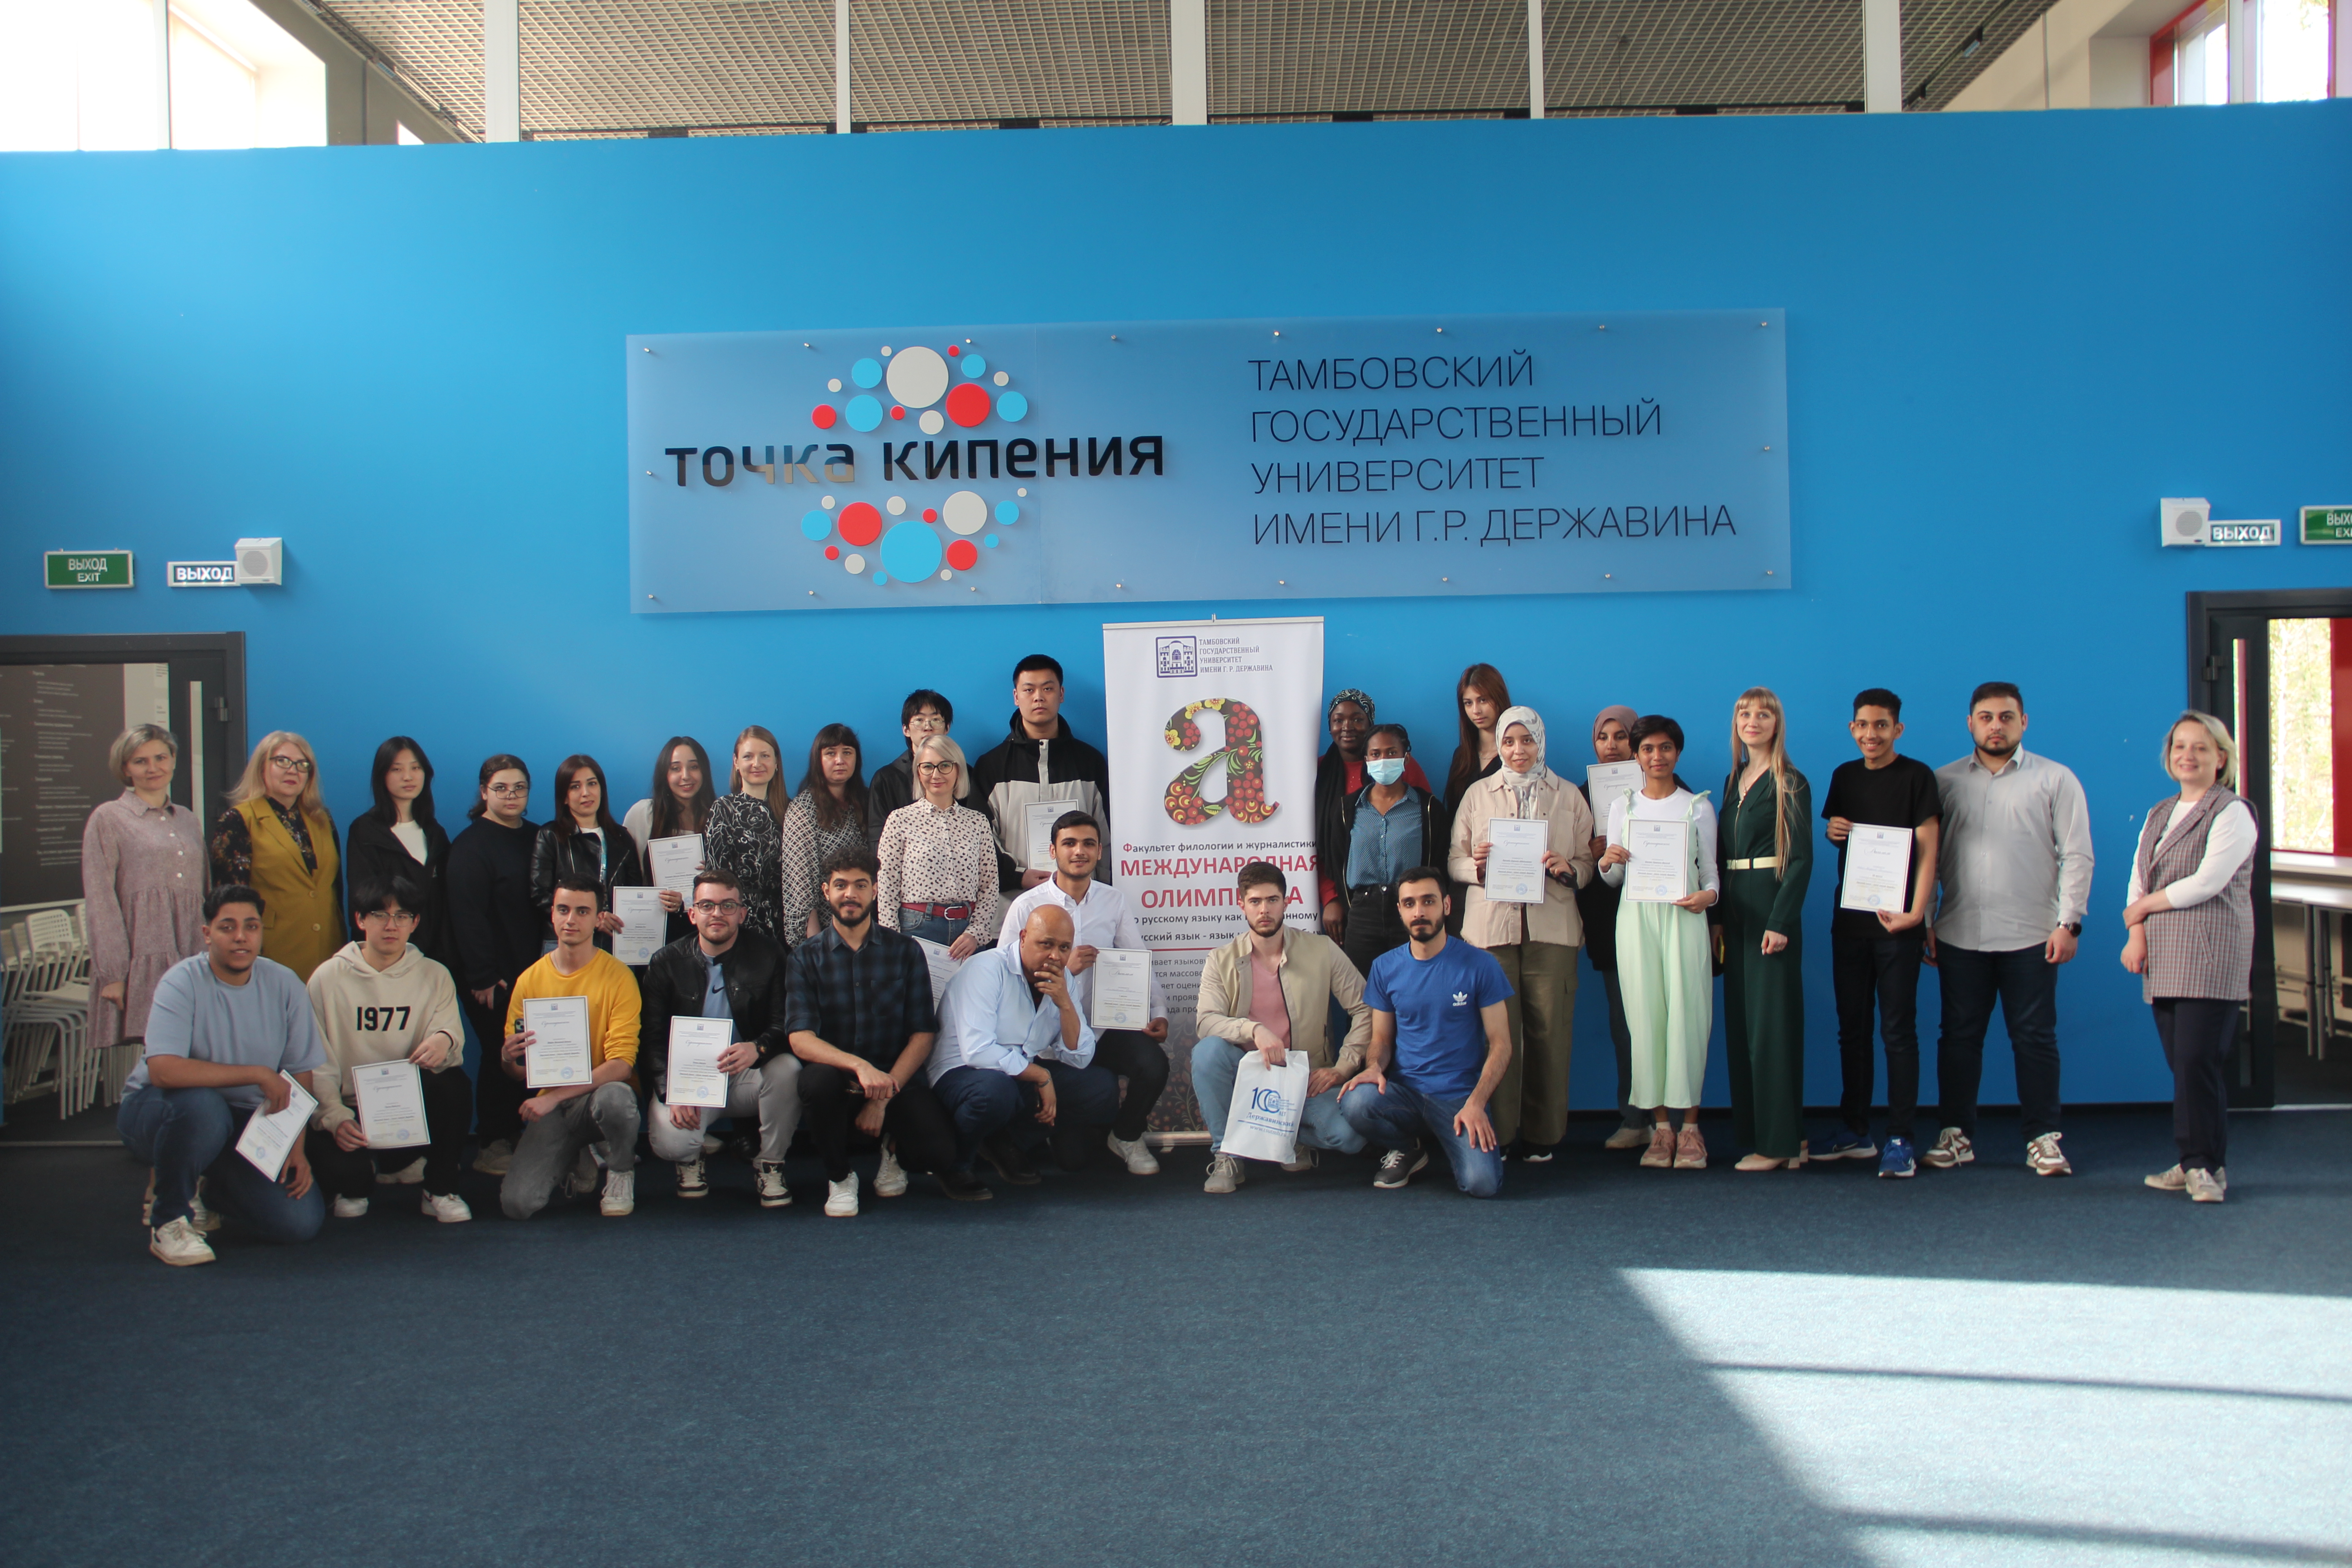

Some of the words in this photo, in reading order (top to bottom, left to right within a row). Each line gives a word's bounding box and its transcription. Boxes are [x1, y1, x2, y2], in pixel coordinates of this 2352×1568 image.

[1248, 349, 1533, 391] ТАМБОВСКИЙ
[1251, 397, 1662, 446] ГОСУДАРСТВЕННЫЙ
[1250, 456, 1544, 495] УНИВЕРСИТЕТ
[1255, 511, 1401, 545] ИМЕНИ
[1416, 510, 1469, 543] Г.Р.
[1480, 505, 1737, 547] ДЕРЖАВИНА
[2327, 513, 2352, 526] ВЫХ
[2213, 526, 2273, 540] ВЫХОД
[2336, 527, 2352, 538] EXI
[69, 558, 108, 573] ВЫХОД
[77, 573, 100, 583] EXIT
[176, 567, 233, 581] ВЫХОД
[1199, 637, 1240, 646] ТАМБОВСКИЙ
[1199, 645, 1259, 655] ГОСУДАРСТВЕННЫЙ
[1200, 656, 1242, 664] УНИВЕРСИТЕТ
[1235, 664, 1273, 672] ДЕРЖАВИНА
[1123, 843, 1175, 853] Факультет
[1178, 842, 1234, 853] филологии
[1245, 840, 1316, 851] журналистики
[1141, 886, 1303, 909] ОЛИМПА
[1142, 916, 1189, 926] русскому
[1191, 914, 1222, 923] языку
[1173, 994, 1198, 1002] прояв
[357, 1005, 411, 1032] 1977
[1246, 1112, 1294, 1127] Державинский
